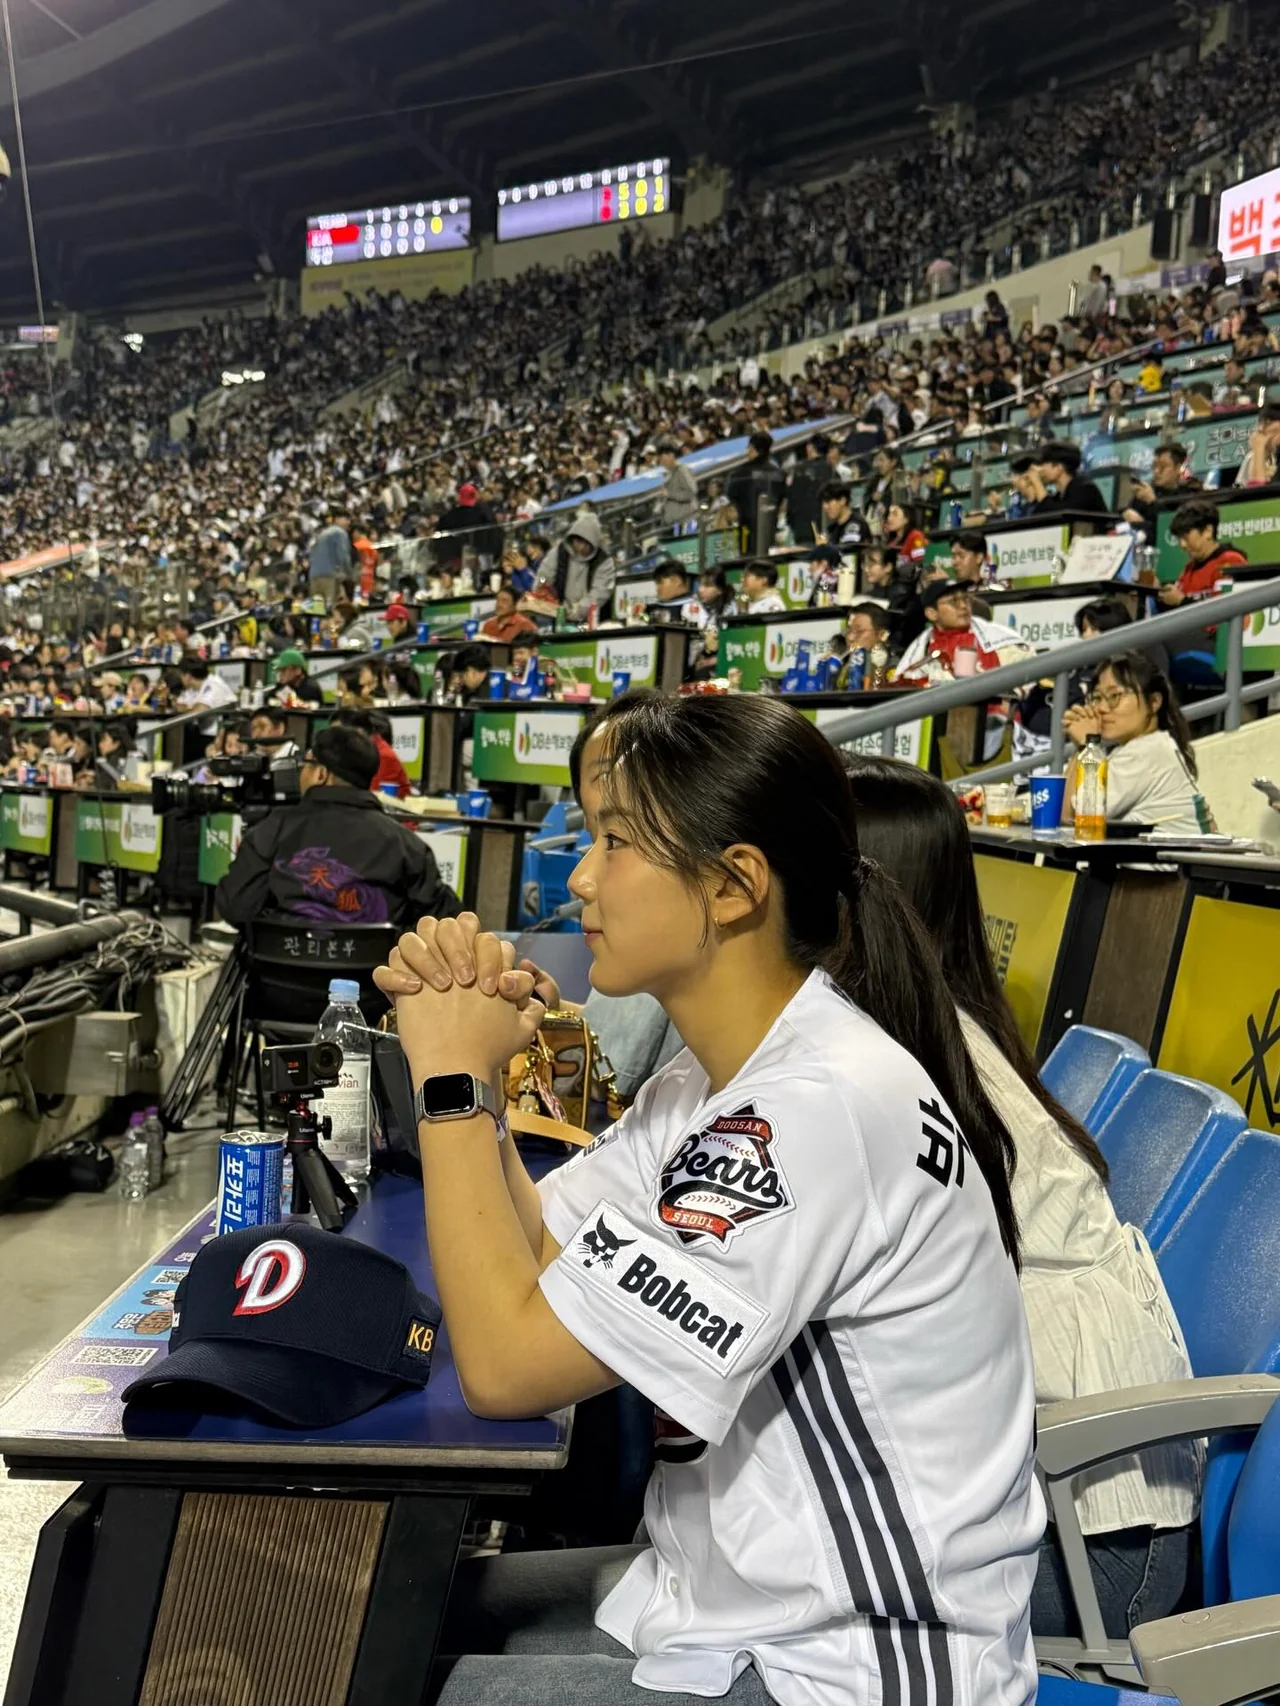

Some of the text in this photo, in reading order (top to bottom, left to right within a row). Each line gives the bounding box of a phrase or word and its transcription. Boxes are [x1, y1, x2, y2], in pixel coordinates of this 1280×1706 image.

[618, 182, 630, 201] 5
[635, 179, 648, 198] 0
[655, 176, 663, 194] 1
[635, 197, 648, 216] 0
[653, 193, 664, 212] 2
[431, 216, 443, 234] 0
[1020, 621, 1076, 643] DB손해보
[338, 1078, 359, 1089] vian
[717, 1120, 763, 1132] DOOSAN
[660, 1133, 783, 1199] Bears
[223, 1154, 244, 1235] 포카리
[672, 1211, 714, 1228] SEOUL
[232, 1239, 307, 1317] D
[617, 1252, 745, 1359] Bobcat
[407, 1323, 434, 1352] KB
